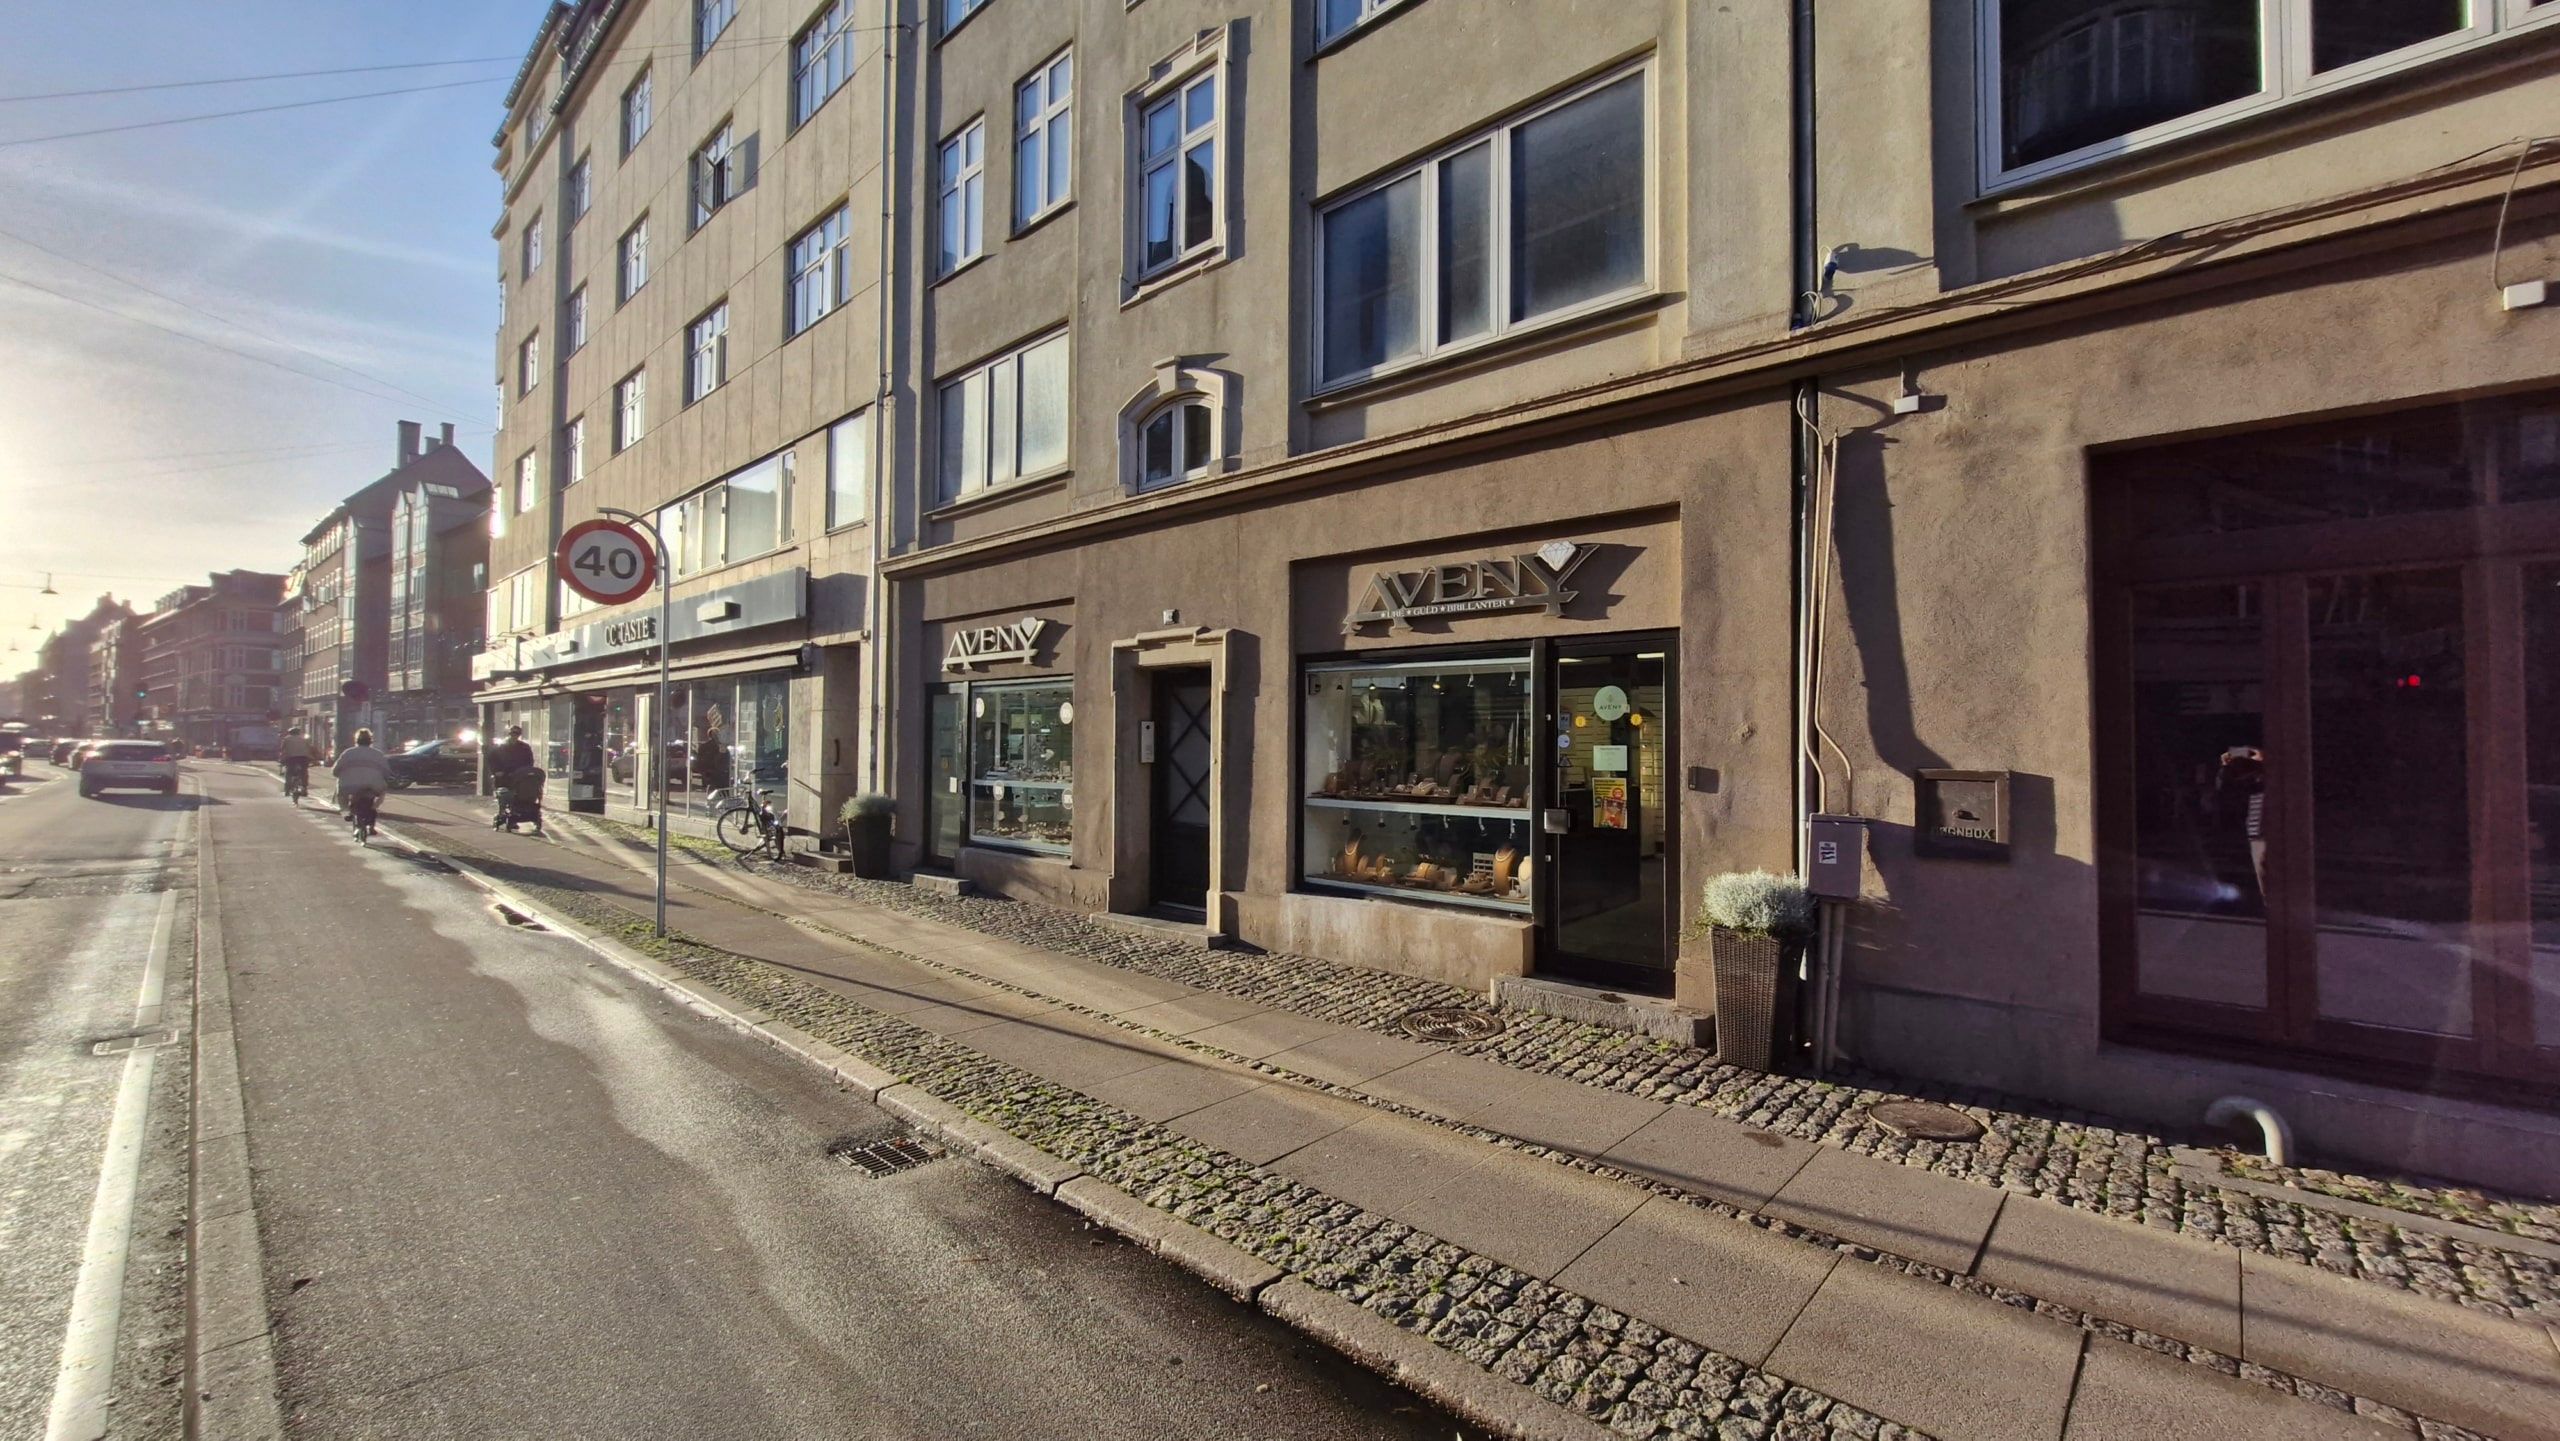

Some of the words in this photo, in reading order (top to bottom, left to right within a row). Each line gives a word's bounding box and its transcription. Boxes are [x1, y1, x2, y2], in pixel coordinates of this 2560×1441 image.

[574, 545, 637, 580] 40
[1340, 543, 1600, 637] AVENY
[1413, 606, 1438, 616] GULD
[1447, 599, 1506, 613] BRILLANTER
[618, 616, 650, 644] TASTE
[940, 619, 1046, 672] AVENY
